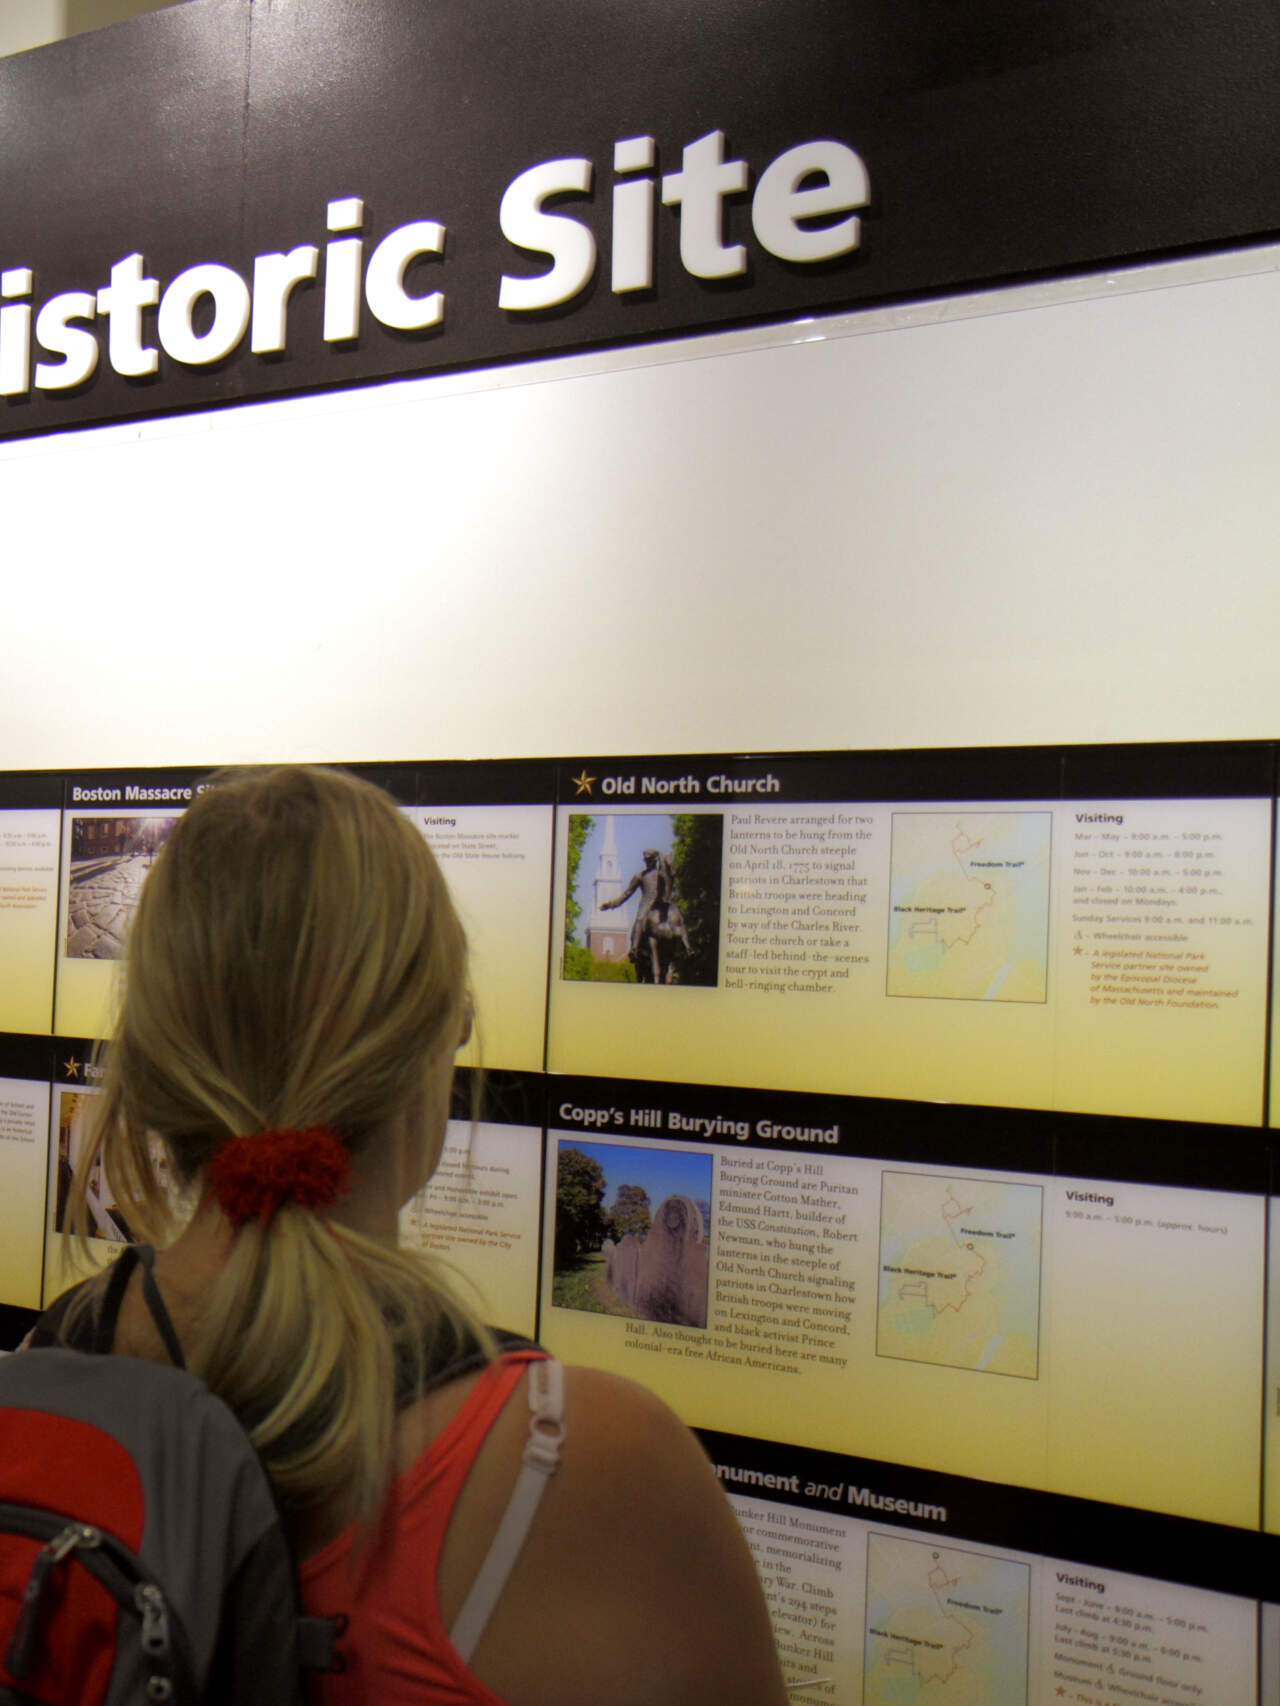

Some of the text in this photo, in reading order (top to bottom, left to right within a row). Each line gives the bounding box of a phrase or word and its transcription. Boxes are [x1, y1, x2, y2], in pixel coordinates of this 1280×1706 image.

[498, 131, 870, 311] Site
[601, 775, 780, 794] Old North Church
[72, 786, 121, 800] Boston
[125, 786, 192, 799] Massacre
[424, 817, 456, 827] Visiting
[730, 814, 873, 827] Paul Revere arranged for two
[1075, 813, 1124, 825] Visiting
[730, 829, 872, 841] lanterns to be hung from the
[728, 845, 856, 857] Old North Church steeple
[743, 860, 769, 872] April
[812, 861, 822, 870] to
[824, 860, 855, 872] signal
[728, 875, 868, 887] patriots in Charlestown that
[728, 890, 762, 900] British
[764, 891, 796, 902] troops
[824, 890, 867, 903] heading
[727, 904, 856, 917] to Lexington and Concord
[726, 919, 738, 931] by
[740, 922, 759, 932] way
[760, 920, 772, 929] of
[771, 920, 789, 930] the
[790, 920, 830, 930] Charles
[726, 934, 749, 944] Tour
[751, 935, 767, 945] the
[768, 935, 804, 946] church
[819, 937, 842, 947] take
[725, 964, 849, 979] tour to visit the crypt and
[724, 978, 786, 993] bell-ringing
[559, 1104, 838, 1142] Copp's Hill Burying Ground
[720, 1157, 823, 1175] Buried at Copp's Hill
[720, 1171, 858, 1194] Burying Ground are Puritan
[719, 1188, 762, 1200] minister
[762, 1192, 798, 1204] Cotton
[1065, 1190, 1115, 1207] Visiting
[718, 1202, 760, 1215] Edmund
[794, 1209, 834, 1222] builder
[834, 1214, 846, 1223] of
[717, 1217, 734, 1227] the
[736, 1219, 756, 1230] USS
[822, 1227, 858, 1240] Robert
[765, 1238, 787, 1248] who
[788, 1239, 815, 1254] hung
[816, 1243, 833, 1253] the
[716, 1248, 841, 1269] lanterns in the steeple of
[715, 1262, 855, 1289] Old North Church signaling
[715, 1280, 856, 1303] patriots in Charlestown how
[715, 1464, 948, 1522] nument and Museum
[734, 1508, 846, 1534] unker Hill Monument
[1055, 1572, 1106, 1594] Visiting
